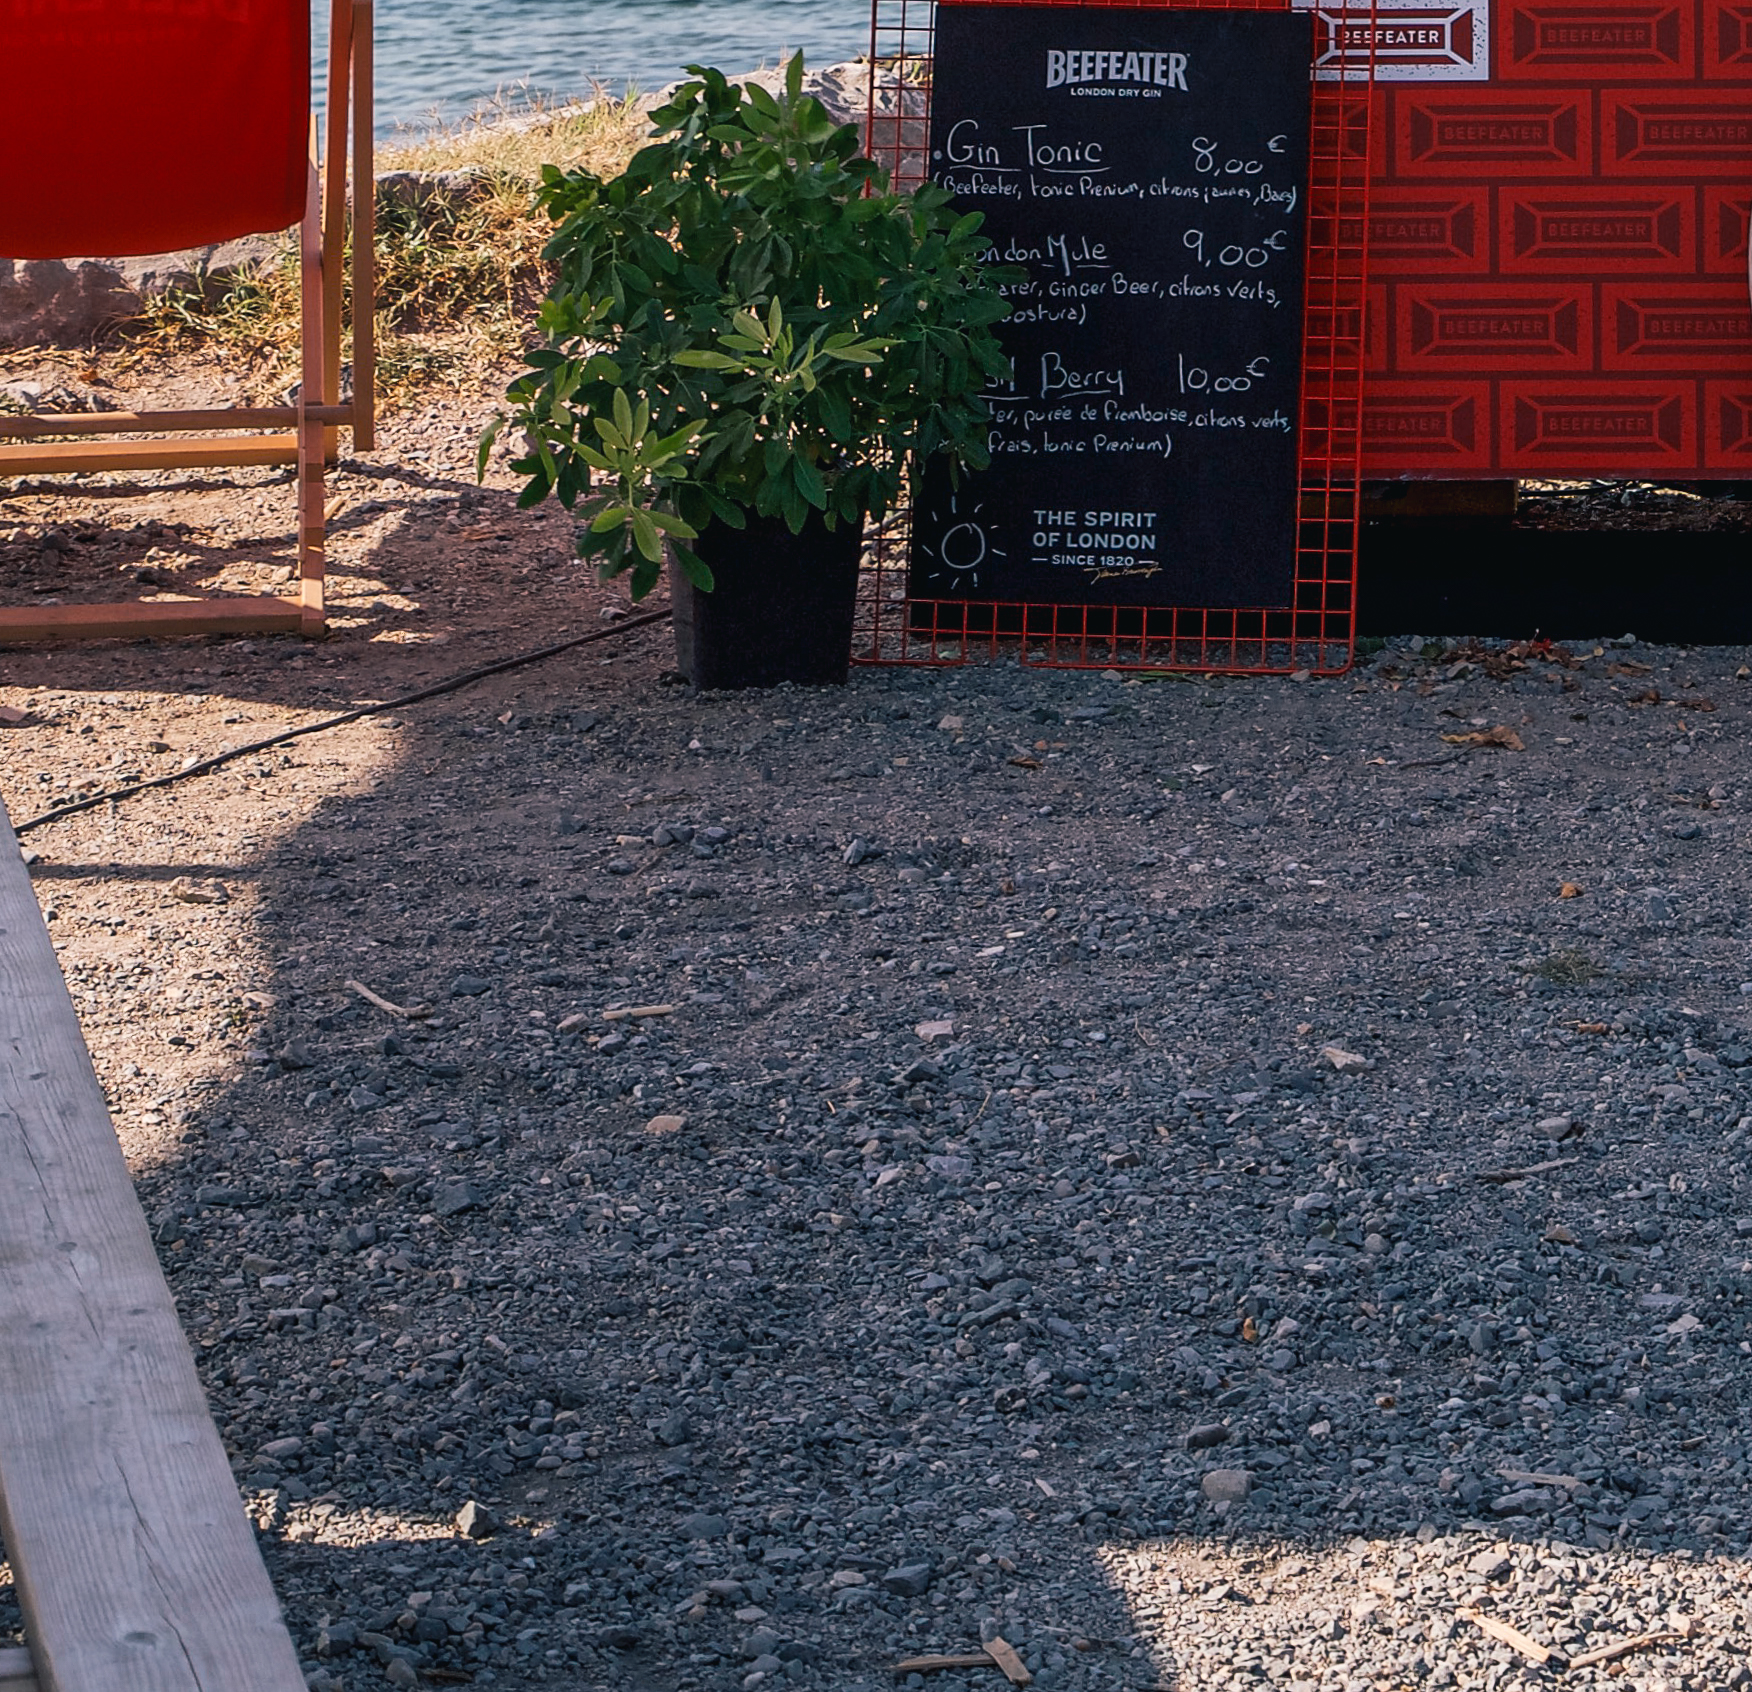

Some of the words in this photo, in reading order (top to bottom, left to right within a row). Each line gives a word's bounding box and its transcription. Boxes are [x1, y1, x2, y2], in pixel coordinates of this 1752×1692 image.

[1546, 28, 1646, 43] BEEFEATER
[1046, 49, 1189, 92] BEEFEATER
[1070, 87, 1116, 96] LONDON
[1118, 88, 1140, 97] DRY
[1142, 89, 1162, 98] GIN
[1444, 125, 1544, 140] BEEFEATER
[1649, 124, 1749, 139] BEEFEATER
[947, 119, 1000, 165] Gin
[1012, 124, 1102, 166] Tonic
[1547, 222, 1647, 237] BEEFEATER
[974, 237, 1042, 262] ondon
[1046, 233, 1108, 277] Mule
[1111, 272, 1165, 299] Beer,
[1444, 319, 1544, 334] BEEFEATER
[1650, 318, 1750, 333] BEEFEATER
[1040, 351, 1124, 398] Berry
[1080, 403, 1097, 421] de
[1548, 416, 1648, 431] BEEFEATER
[1033, 510, 1076, 526] THE
[1084, 511, 1157, 528] SPIRIT
[1032, 531, 1061, 547] OF
[1066, 532, 1156, 550] LONDON
[1051, 554, 1096, 566] SINCE
[1100, 555, 1135, 567] 1820
